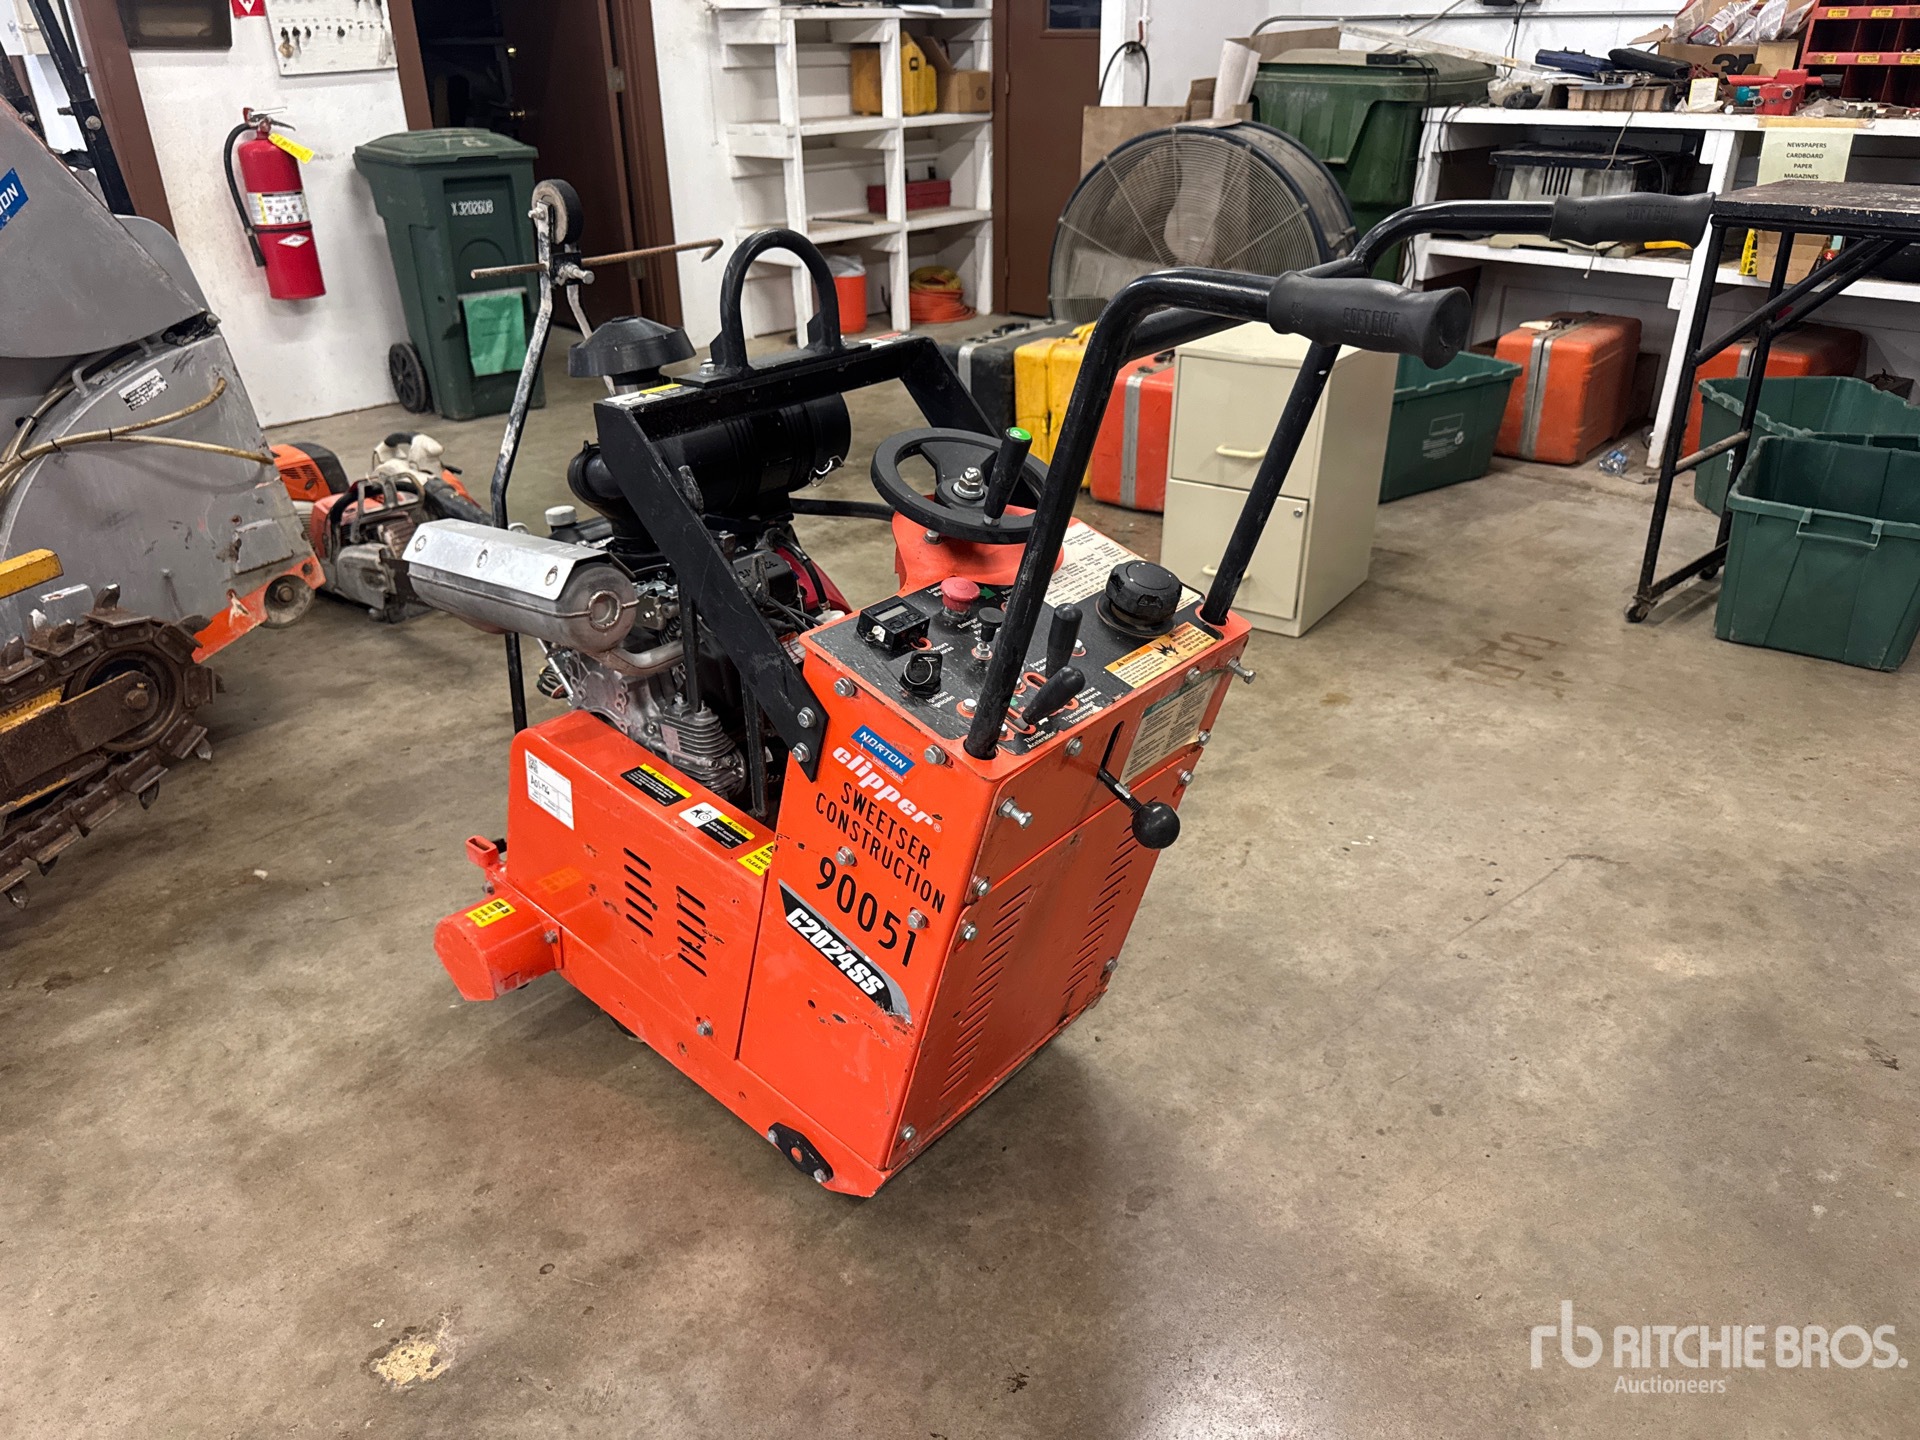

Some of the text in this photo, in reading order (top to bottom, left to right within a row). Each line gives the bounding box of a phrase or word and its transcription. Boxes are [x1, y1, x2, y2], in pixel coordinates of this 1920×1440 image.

[859, 731, 907, 769] NORTON
[1024, 731, 1046, 743] Throttle
[832, 746, 934, 826] clipper
[841, 782, 931, 870] SWEETSER
[816, 792, 946, 914] CONSTRUCTION
[786, 907, 885, 996] C2024SS
[816, 856, 917, 967] 90051
